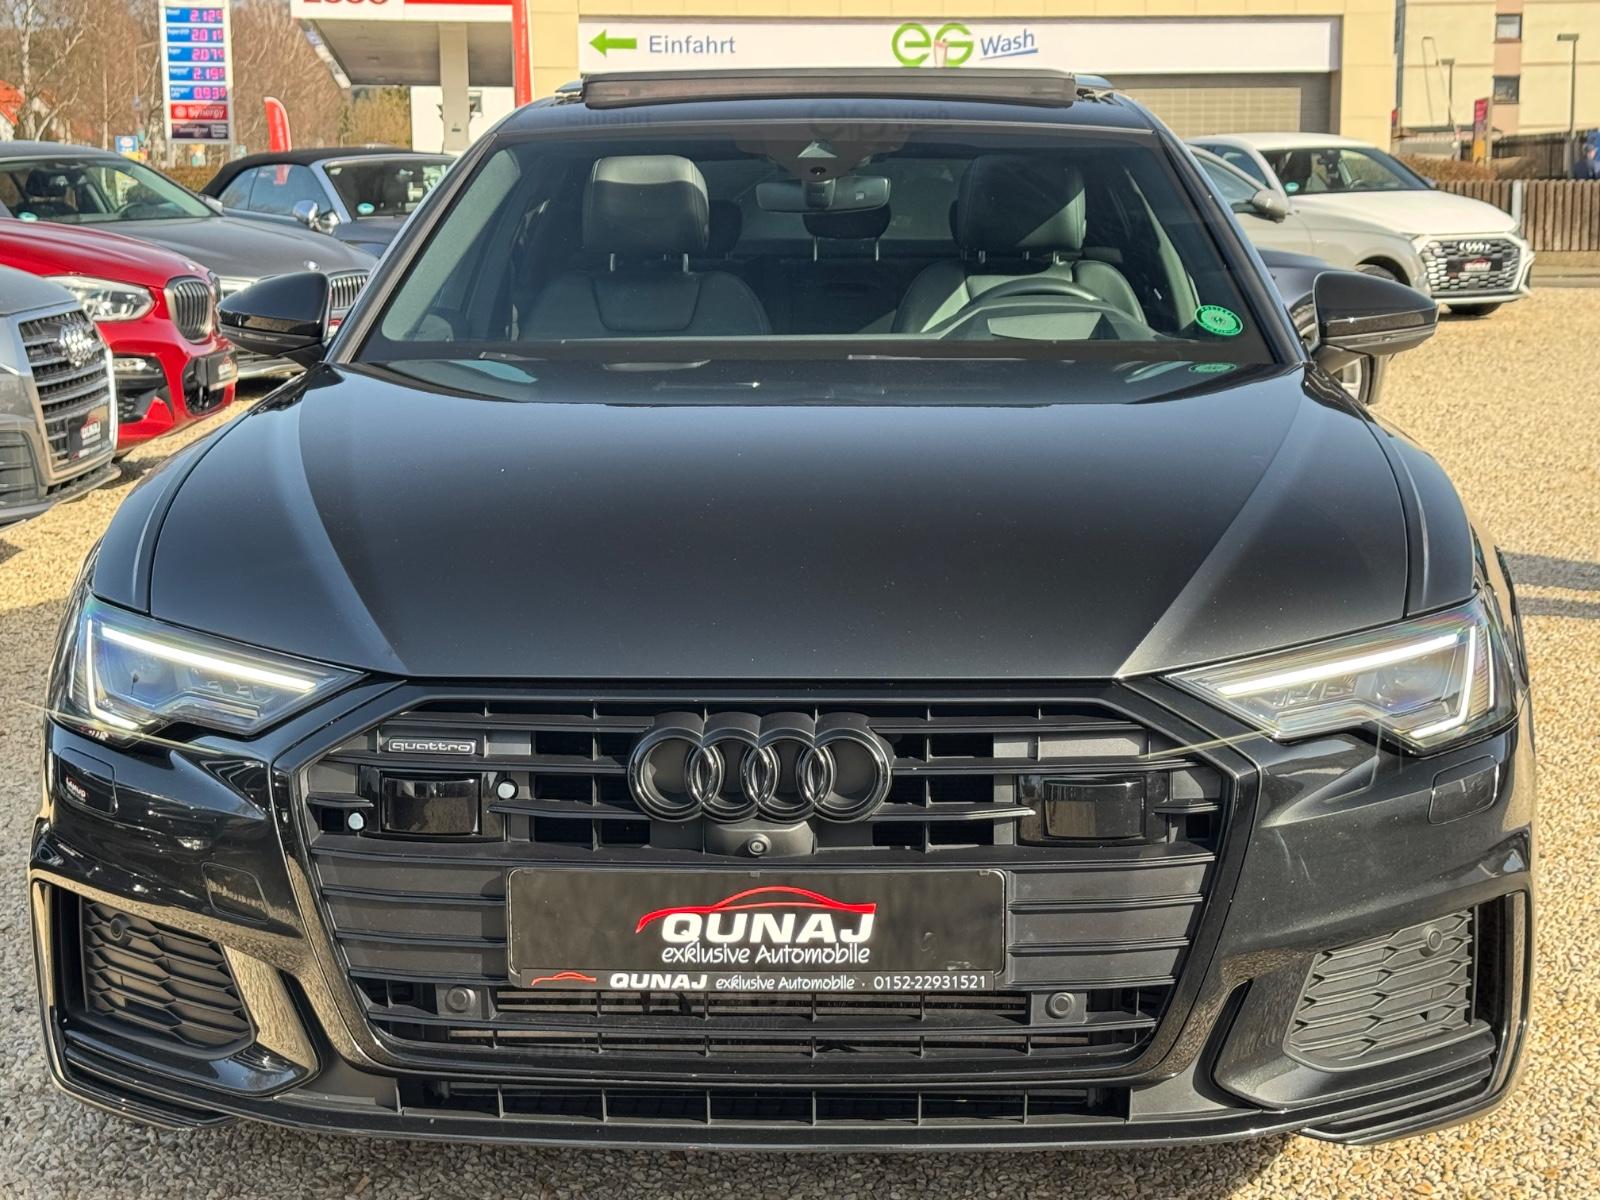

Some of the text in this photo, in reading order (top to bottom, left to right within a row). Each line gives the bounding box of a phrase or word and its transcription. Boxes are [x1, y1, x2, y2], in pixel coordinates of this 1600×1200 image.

[649, 35, 735, 53] Einfahrt
[980, 28, 1035, 56] Wash
[392, 742, 471, 752] quattro
[661, 913, 876, 943] QUNAJ
[661, 943, 870, 964] exklusive Automobile
[609, 973, 987, 990] QUNAJ exklusive Automobile 0152-22931521
